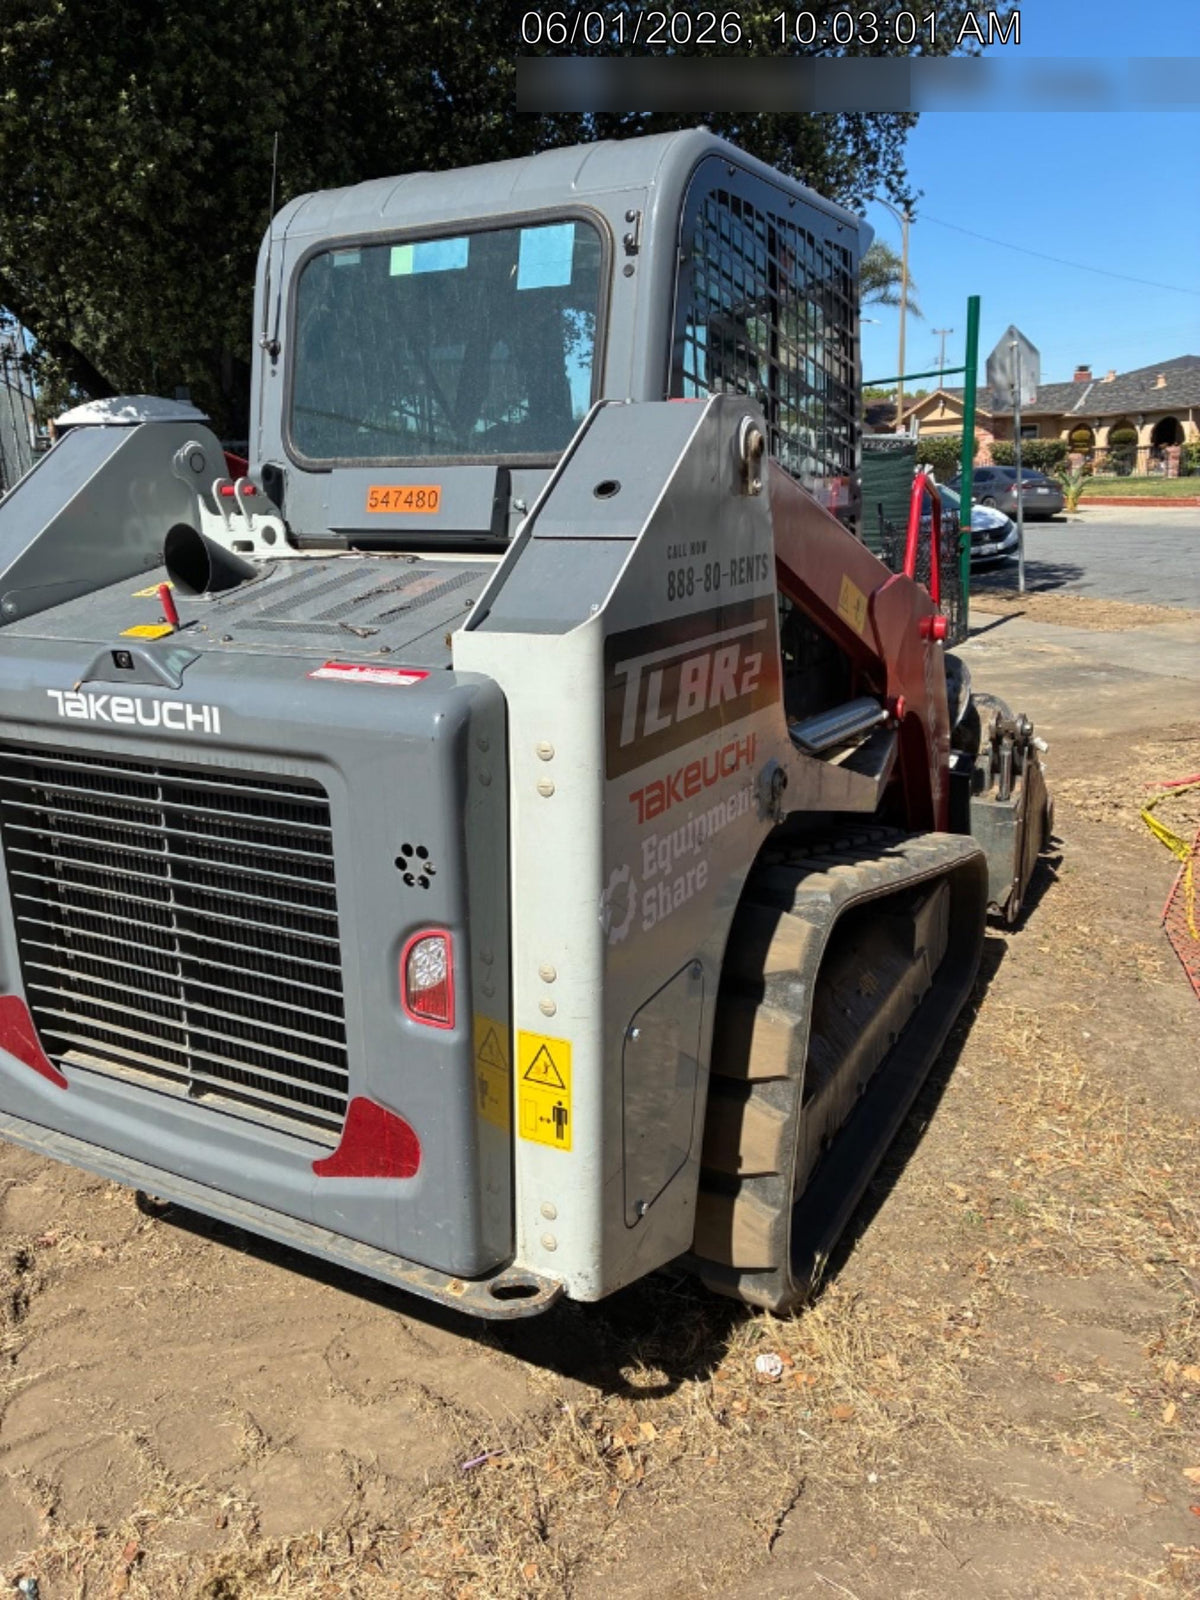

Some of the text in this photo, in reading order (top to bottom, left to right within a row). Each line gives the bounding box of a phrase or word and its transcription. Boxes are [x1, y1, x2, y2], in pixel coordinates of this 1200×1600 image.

[369, 490, 438, 509] 547480
[667, 543, 688, 560] CALL
[667, 553, 768, 601] 888-80-RENTS
[641, 777, 758, 881] Equipment
[641, 859, 708, 931] Share
